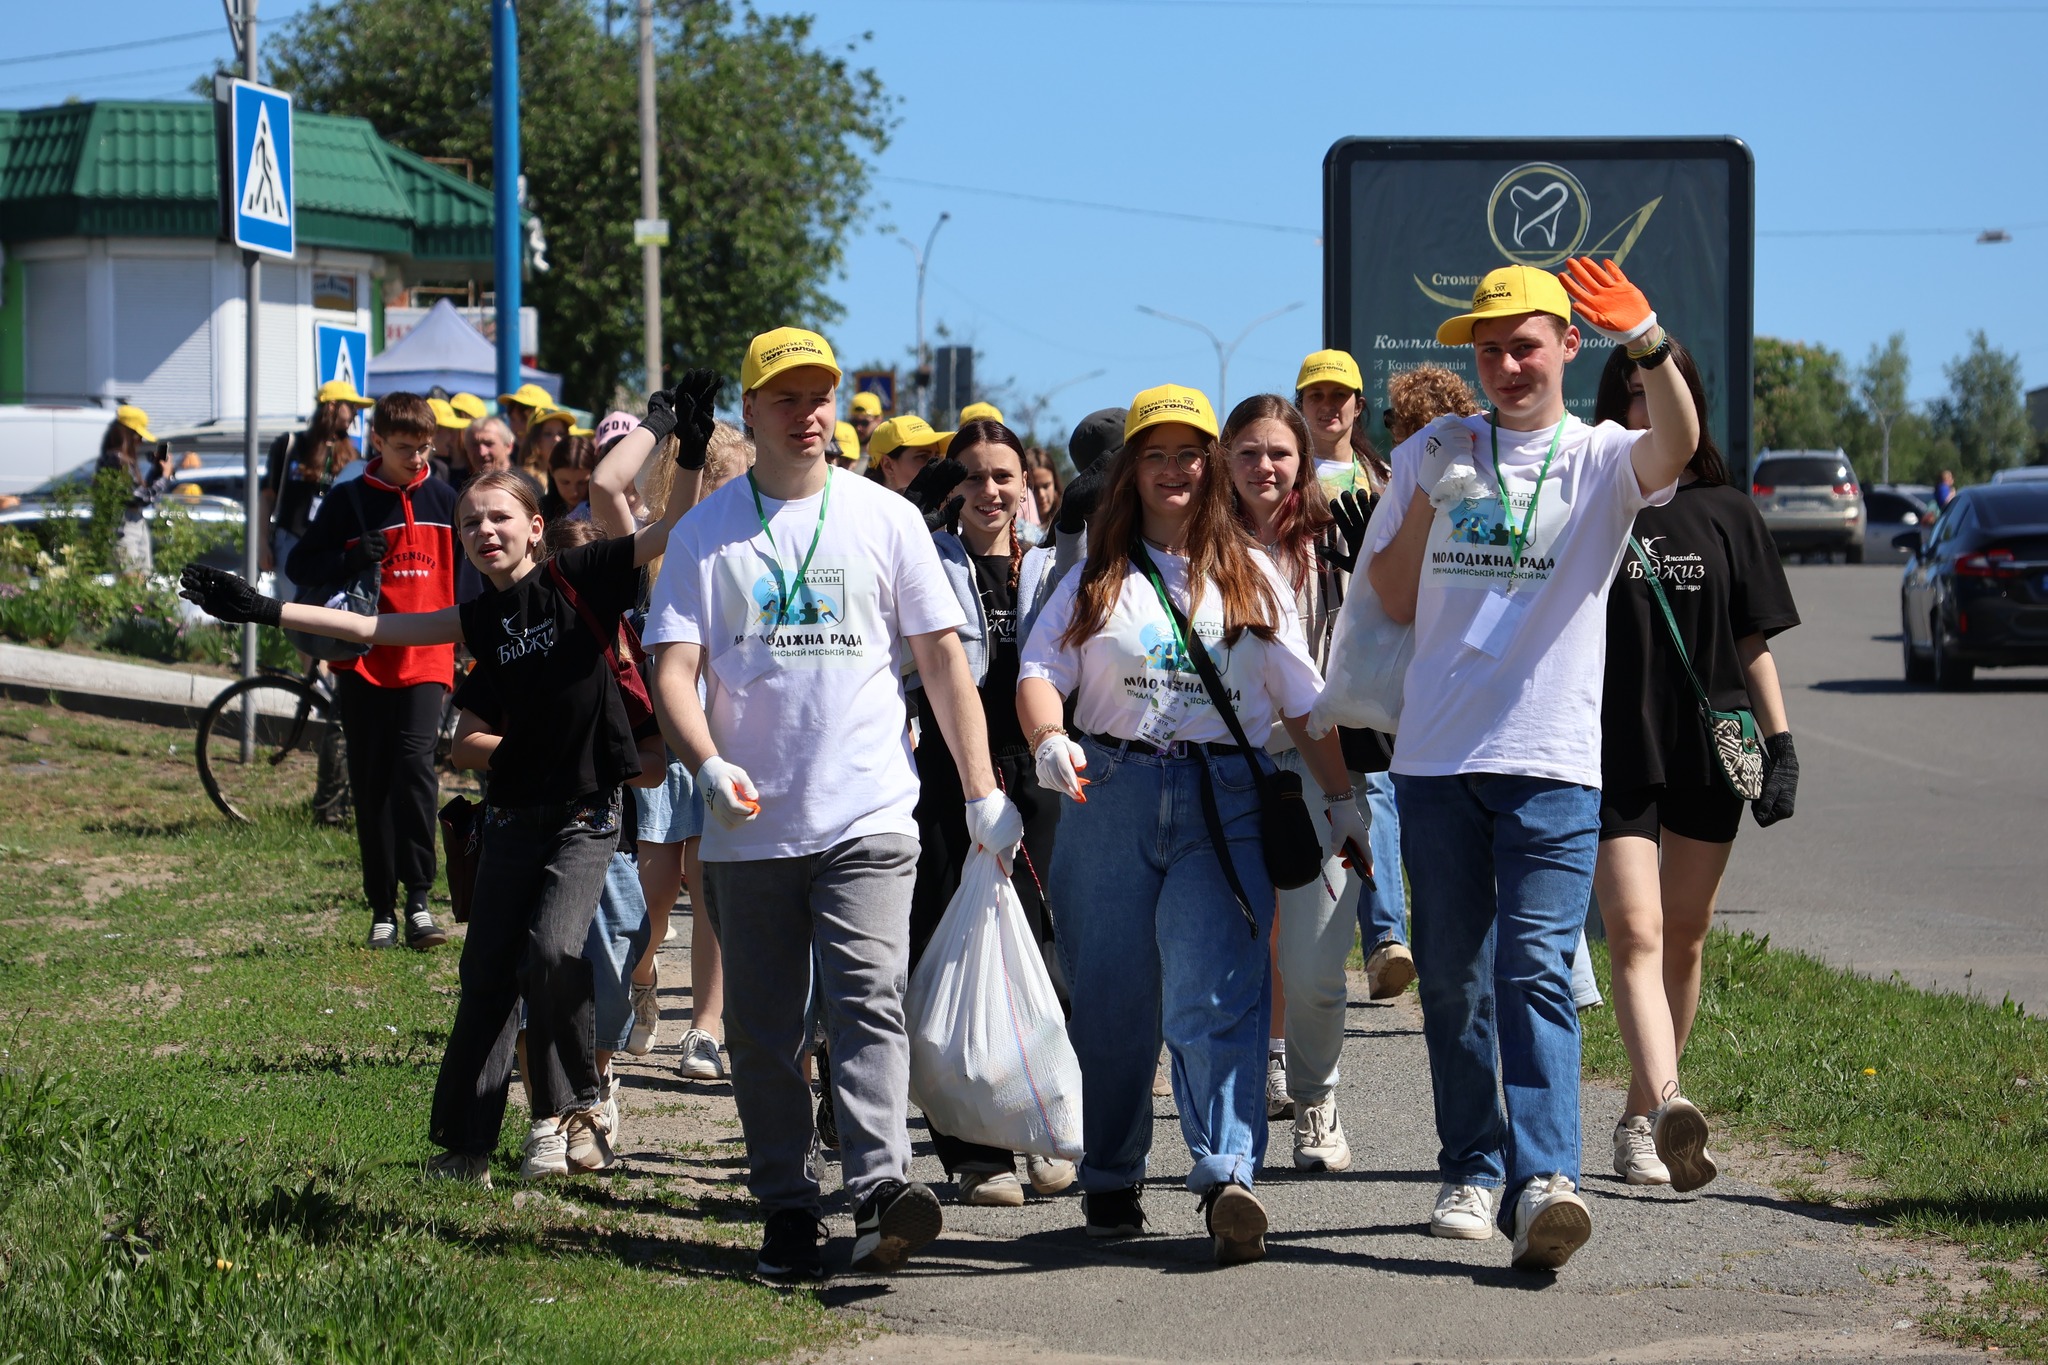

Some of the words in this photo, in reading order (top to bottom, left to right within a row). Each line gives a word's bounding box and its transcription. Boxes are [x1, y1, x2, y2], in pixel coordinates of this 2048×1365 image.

[382, 551, 437, 570] INTENSIVE
[1432, 551, 1513, 567] МОЛОДІЖНА
[1520, 556, 1555, 571] РАДА
[1663, 553, 1702, 562] Ансамбль
[1627, 558, 1706, 584] Бджиз
[830, 633, 862, 648] РАДА
[808, 647, 845, 657] МІСЬКІЙ
